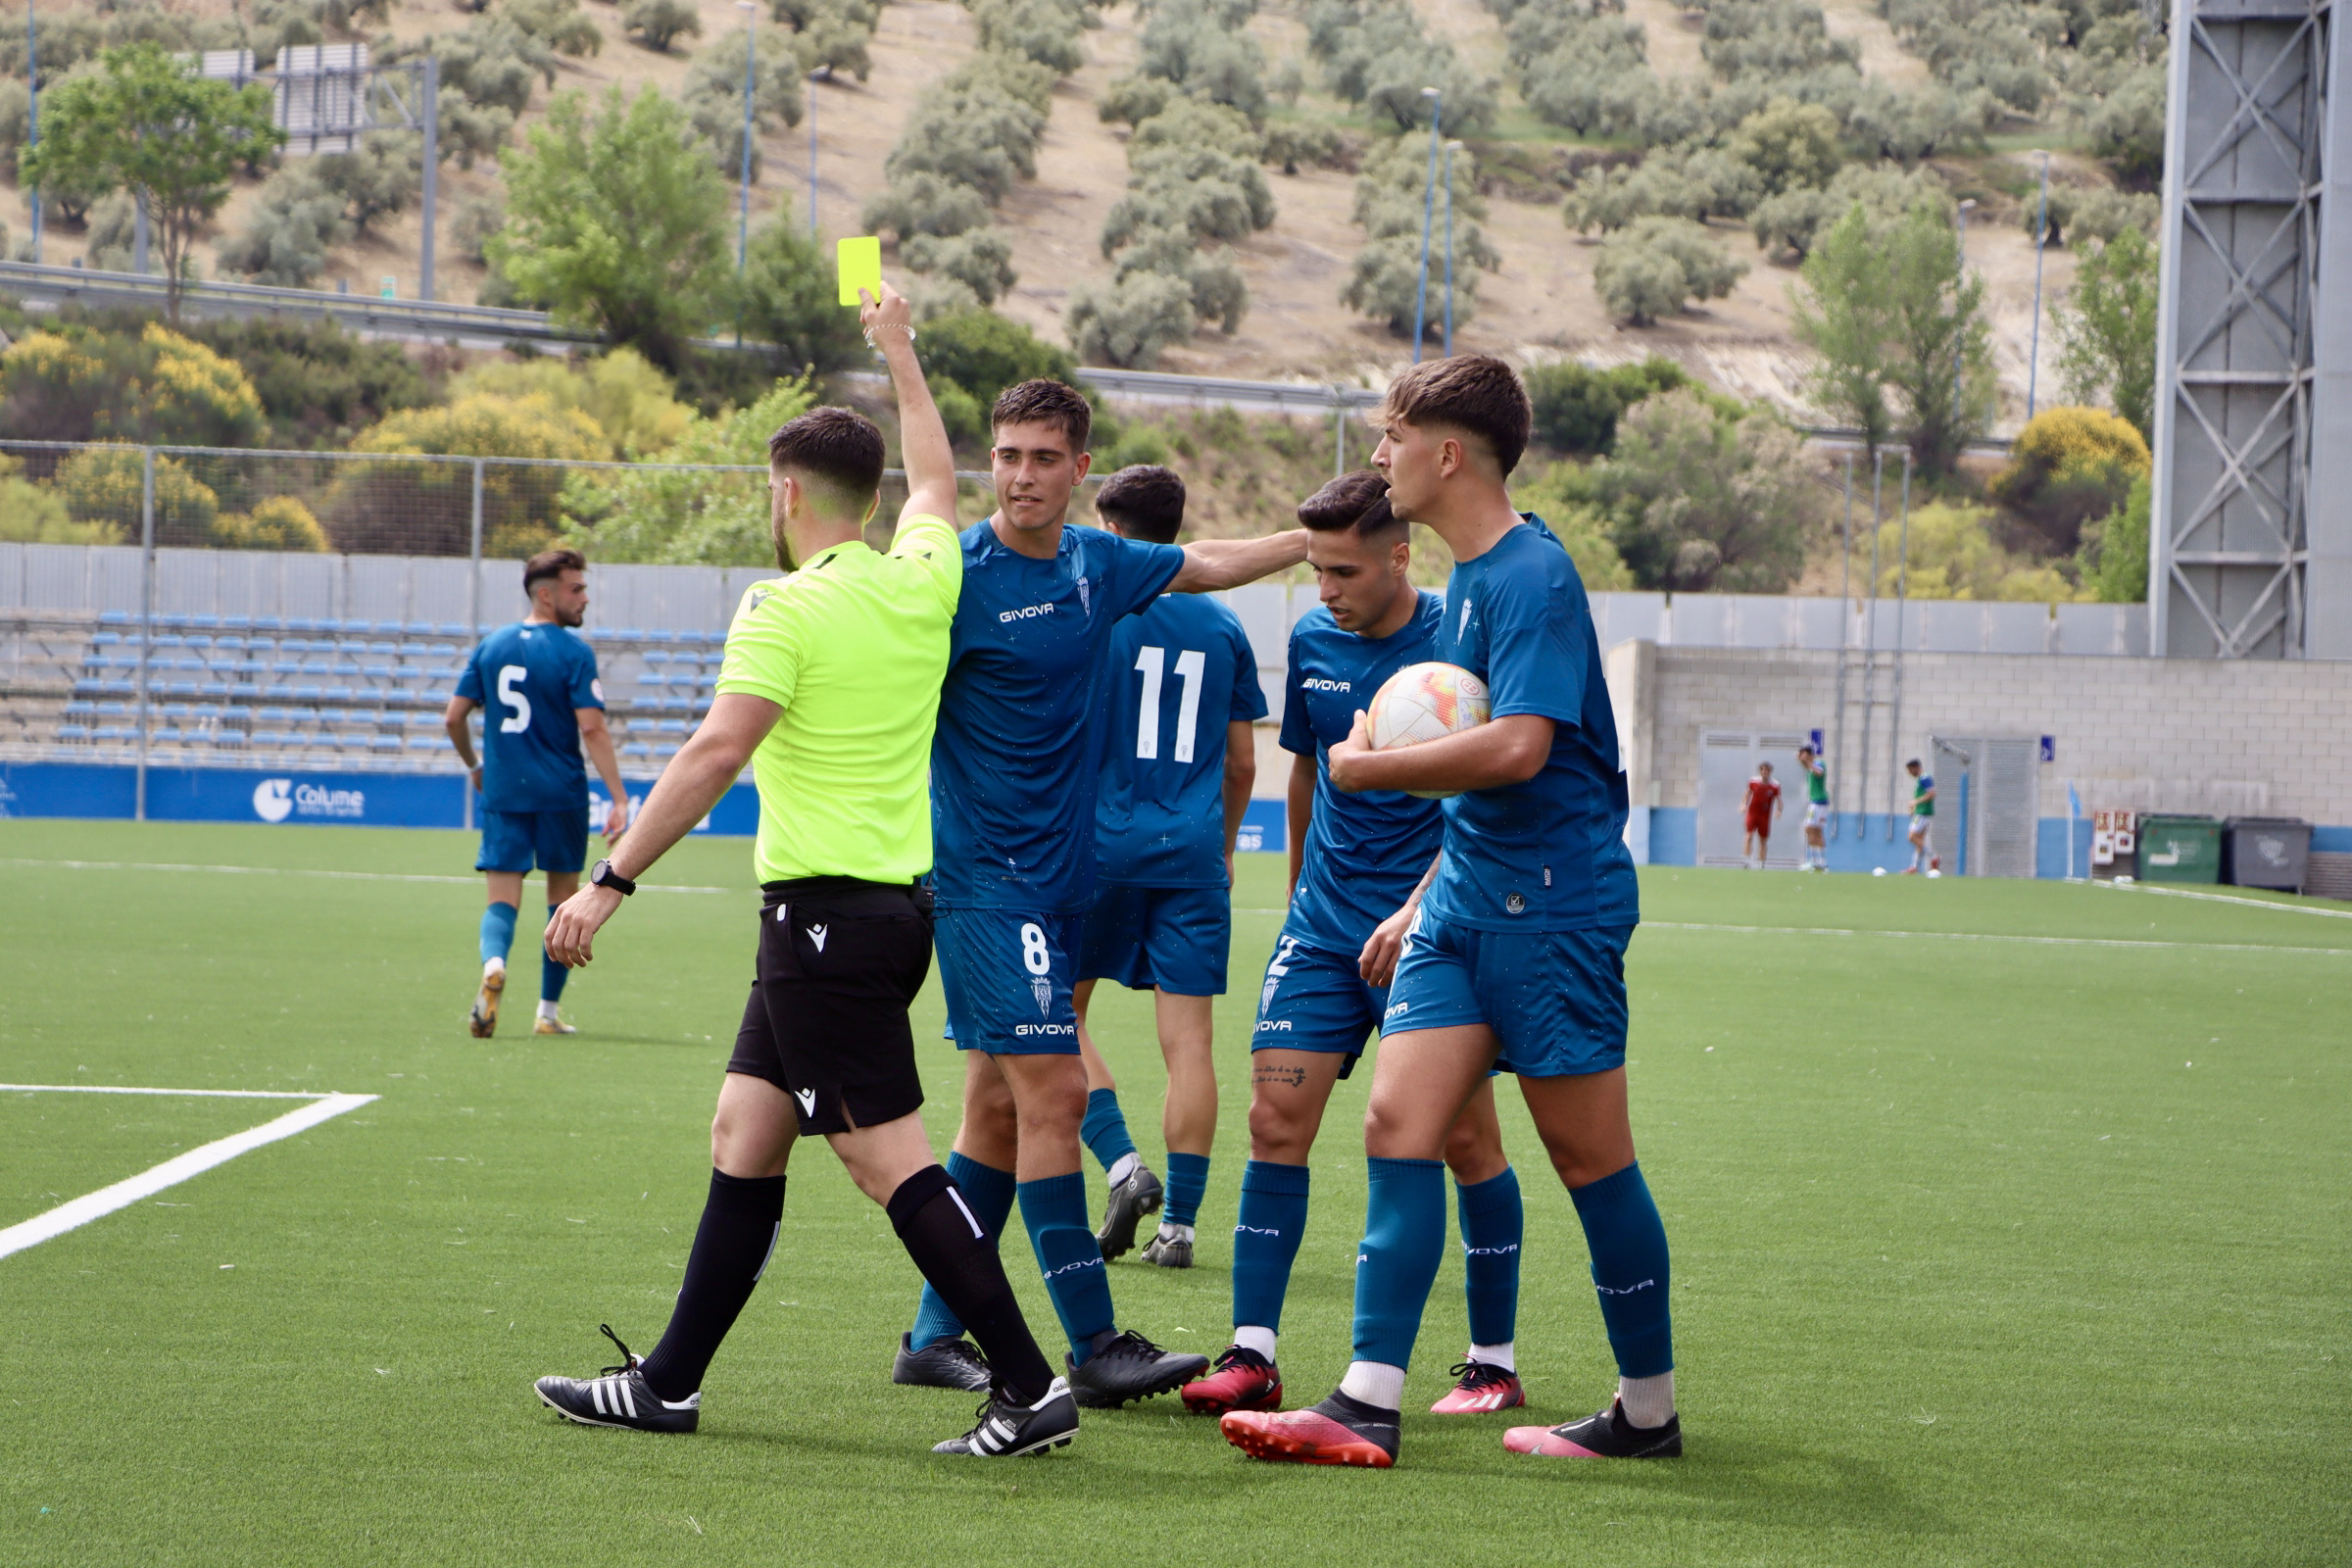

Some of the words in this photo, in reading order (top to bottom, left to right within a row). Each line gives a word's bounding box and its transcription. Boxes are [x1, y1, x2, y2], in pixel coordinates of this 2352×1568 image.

[1000, 603, 1054, 623] GIVOVA
[497, 663, 531, 734] 5
[1300, 677, 1351, 694] GIVOVA
[1134, 645, 1206, 763] 11
[1020, 922, 1051, 975] 8
[1267, 934, 1300, 977] 2
[1384, 1002, 1408, 1020] OVA
[1015, 1024, 1075, 1036] GIVOVA
